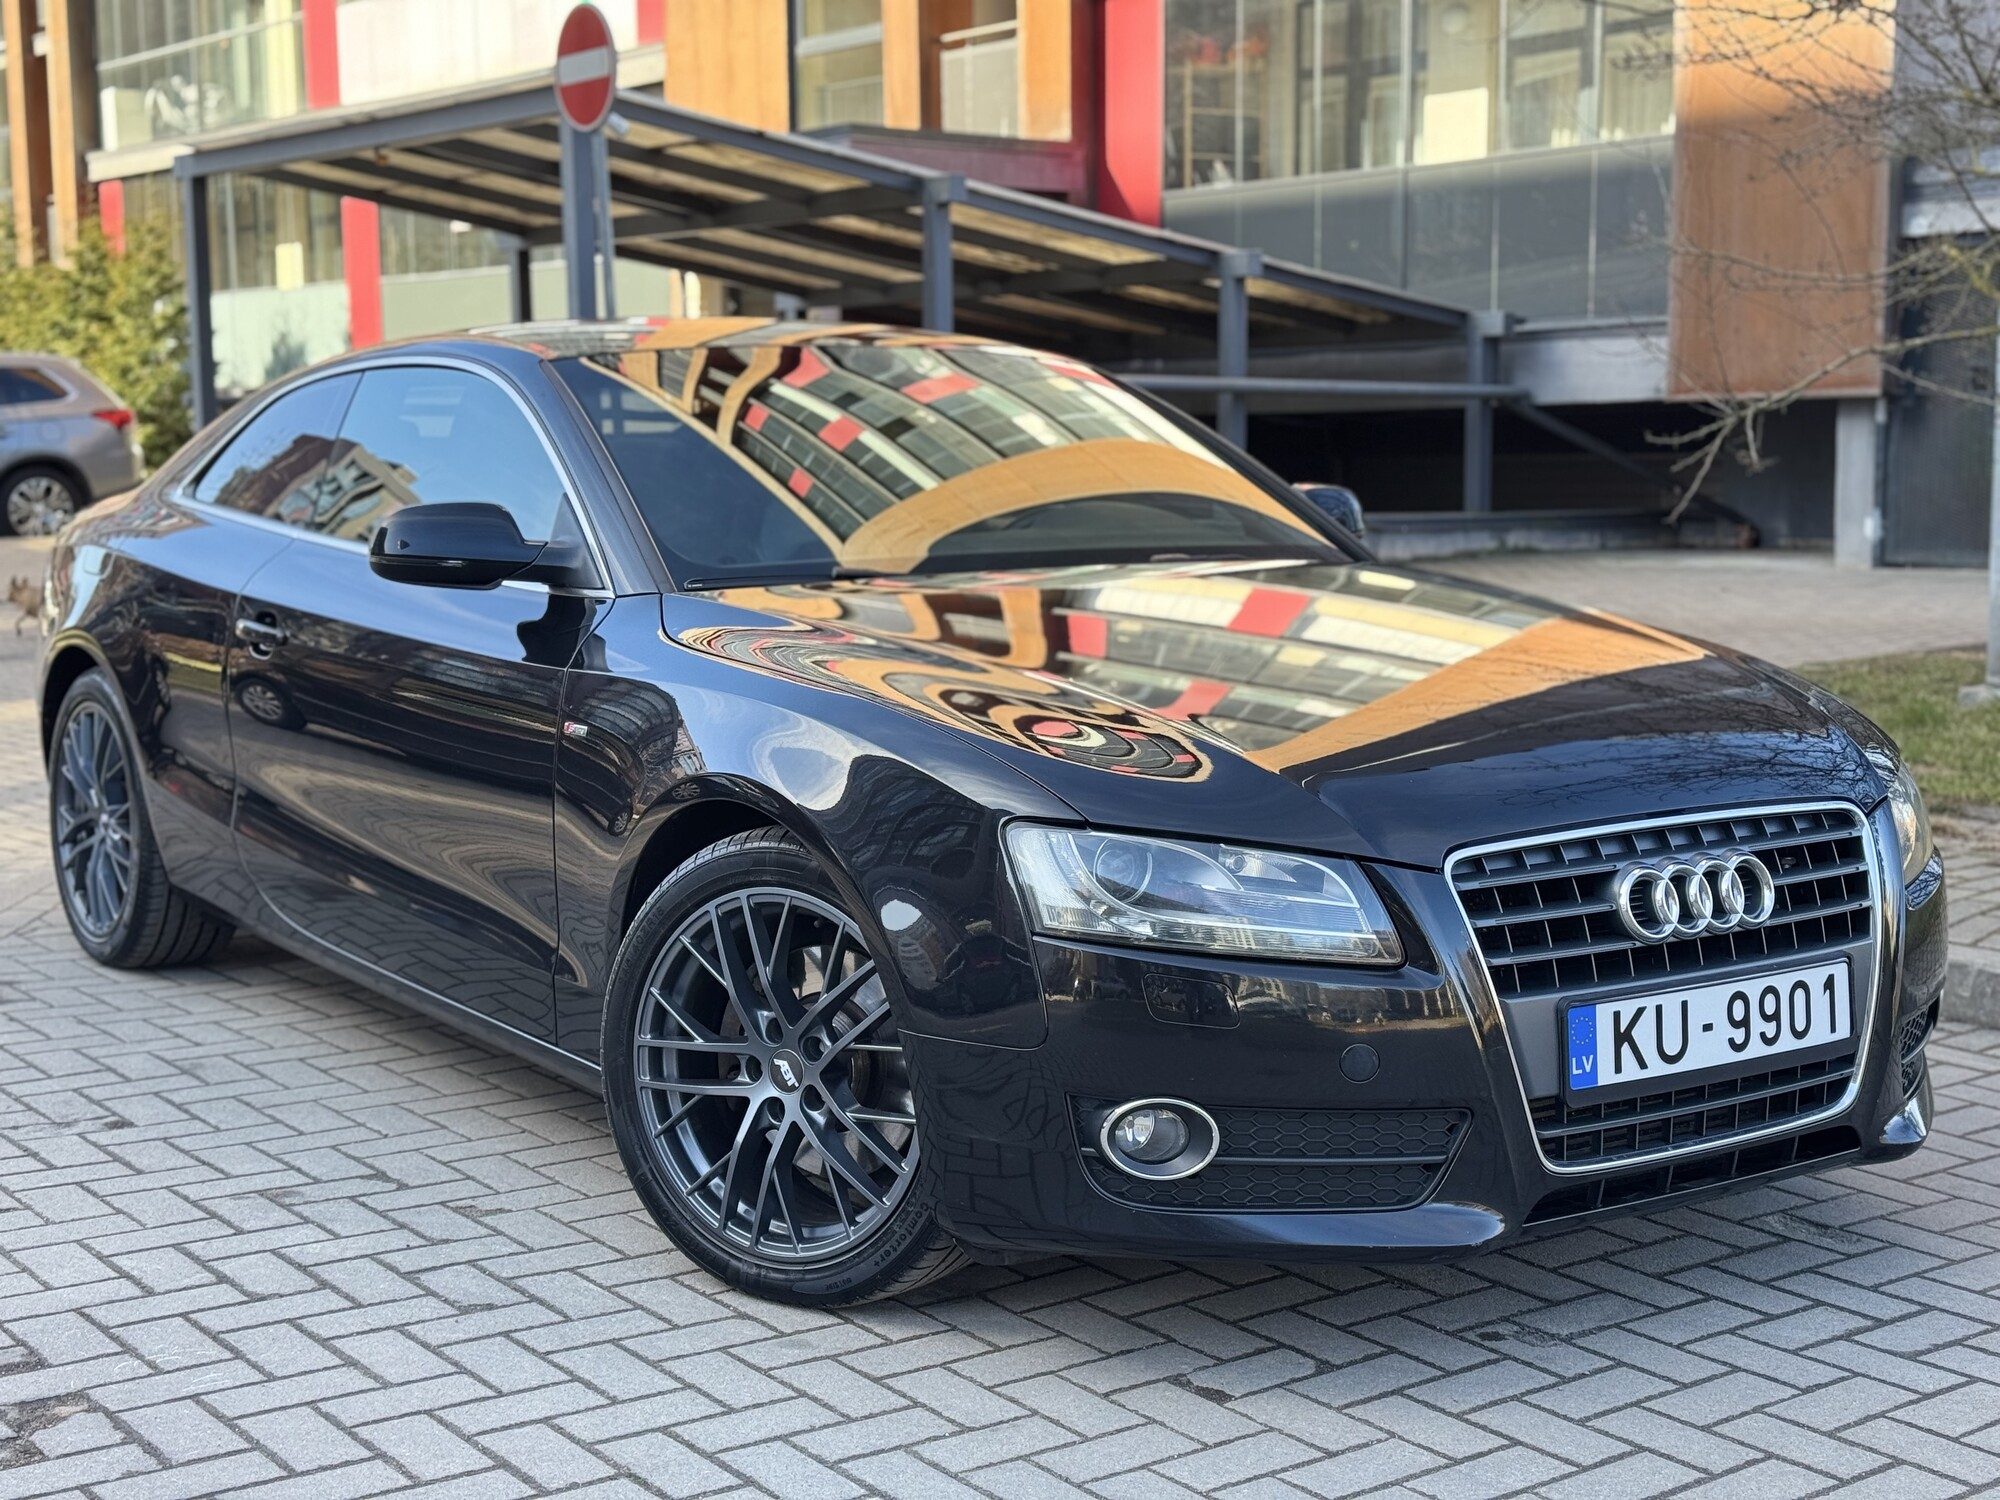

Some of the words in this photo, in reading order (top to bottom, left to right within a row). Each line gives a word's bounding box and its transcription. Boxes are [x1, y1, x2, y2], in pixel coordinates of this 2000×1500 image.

[1612, 973, 1837, 1075] KU-9901
[773, 1058, 800, 1088] ABT
[1571, 1054, 1594, 1076] LV
